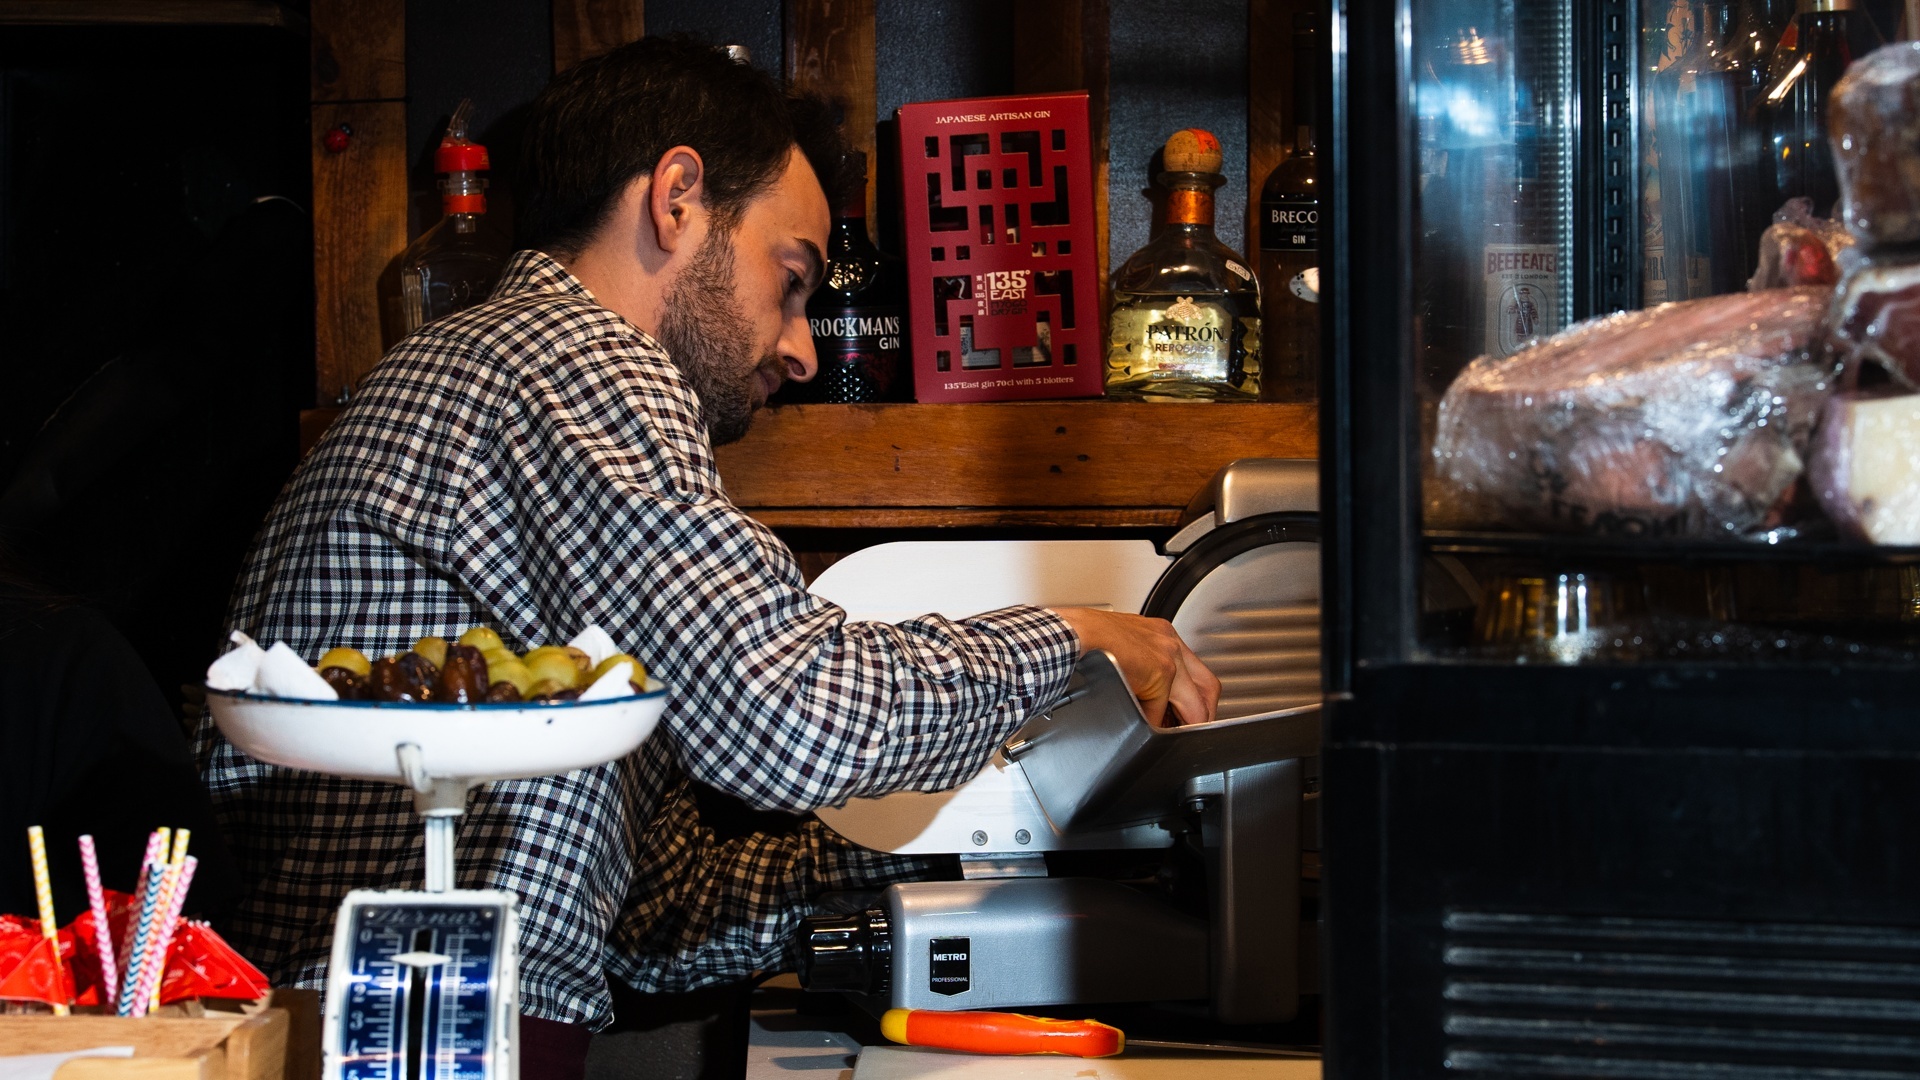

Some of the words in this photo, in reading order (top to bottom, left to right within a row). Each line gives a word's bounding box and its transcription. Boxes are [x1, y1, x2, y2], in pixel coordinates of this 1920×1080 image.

[935, 114, 987, 124] JAPANESE
[988, 111, 1032, 121] ARTISAN
[1033, 110, 1051, 119] GIN
[1292, 234, 1306, 245] GIN
[990, 288, 1027, 301] EAST
[810, 316, 900, 338] ROCKMANS
[1146, 322, 1225, 343] PATRÓN
[879, 337, 900, 349] GIN
[1155, 343, 1216, 353] REPOSADO
[981, 379, 995, 390] gin
[996, 378, 1014, 387] 70cl
[1015, 377, 1034, 386] with
[1043, 376, 1074, 385] blotters
[360, 928, 373, 944] 0
[933, 953, 967, 961] METRO
[357, 957, 366, 975] 1
[353, 984, 367, 1003] 2
[350, 1011, 364, 1030] 3
